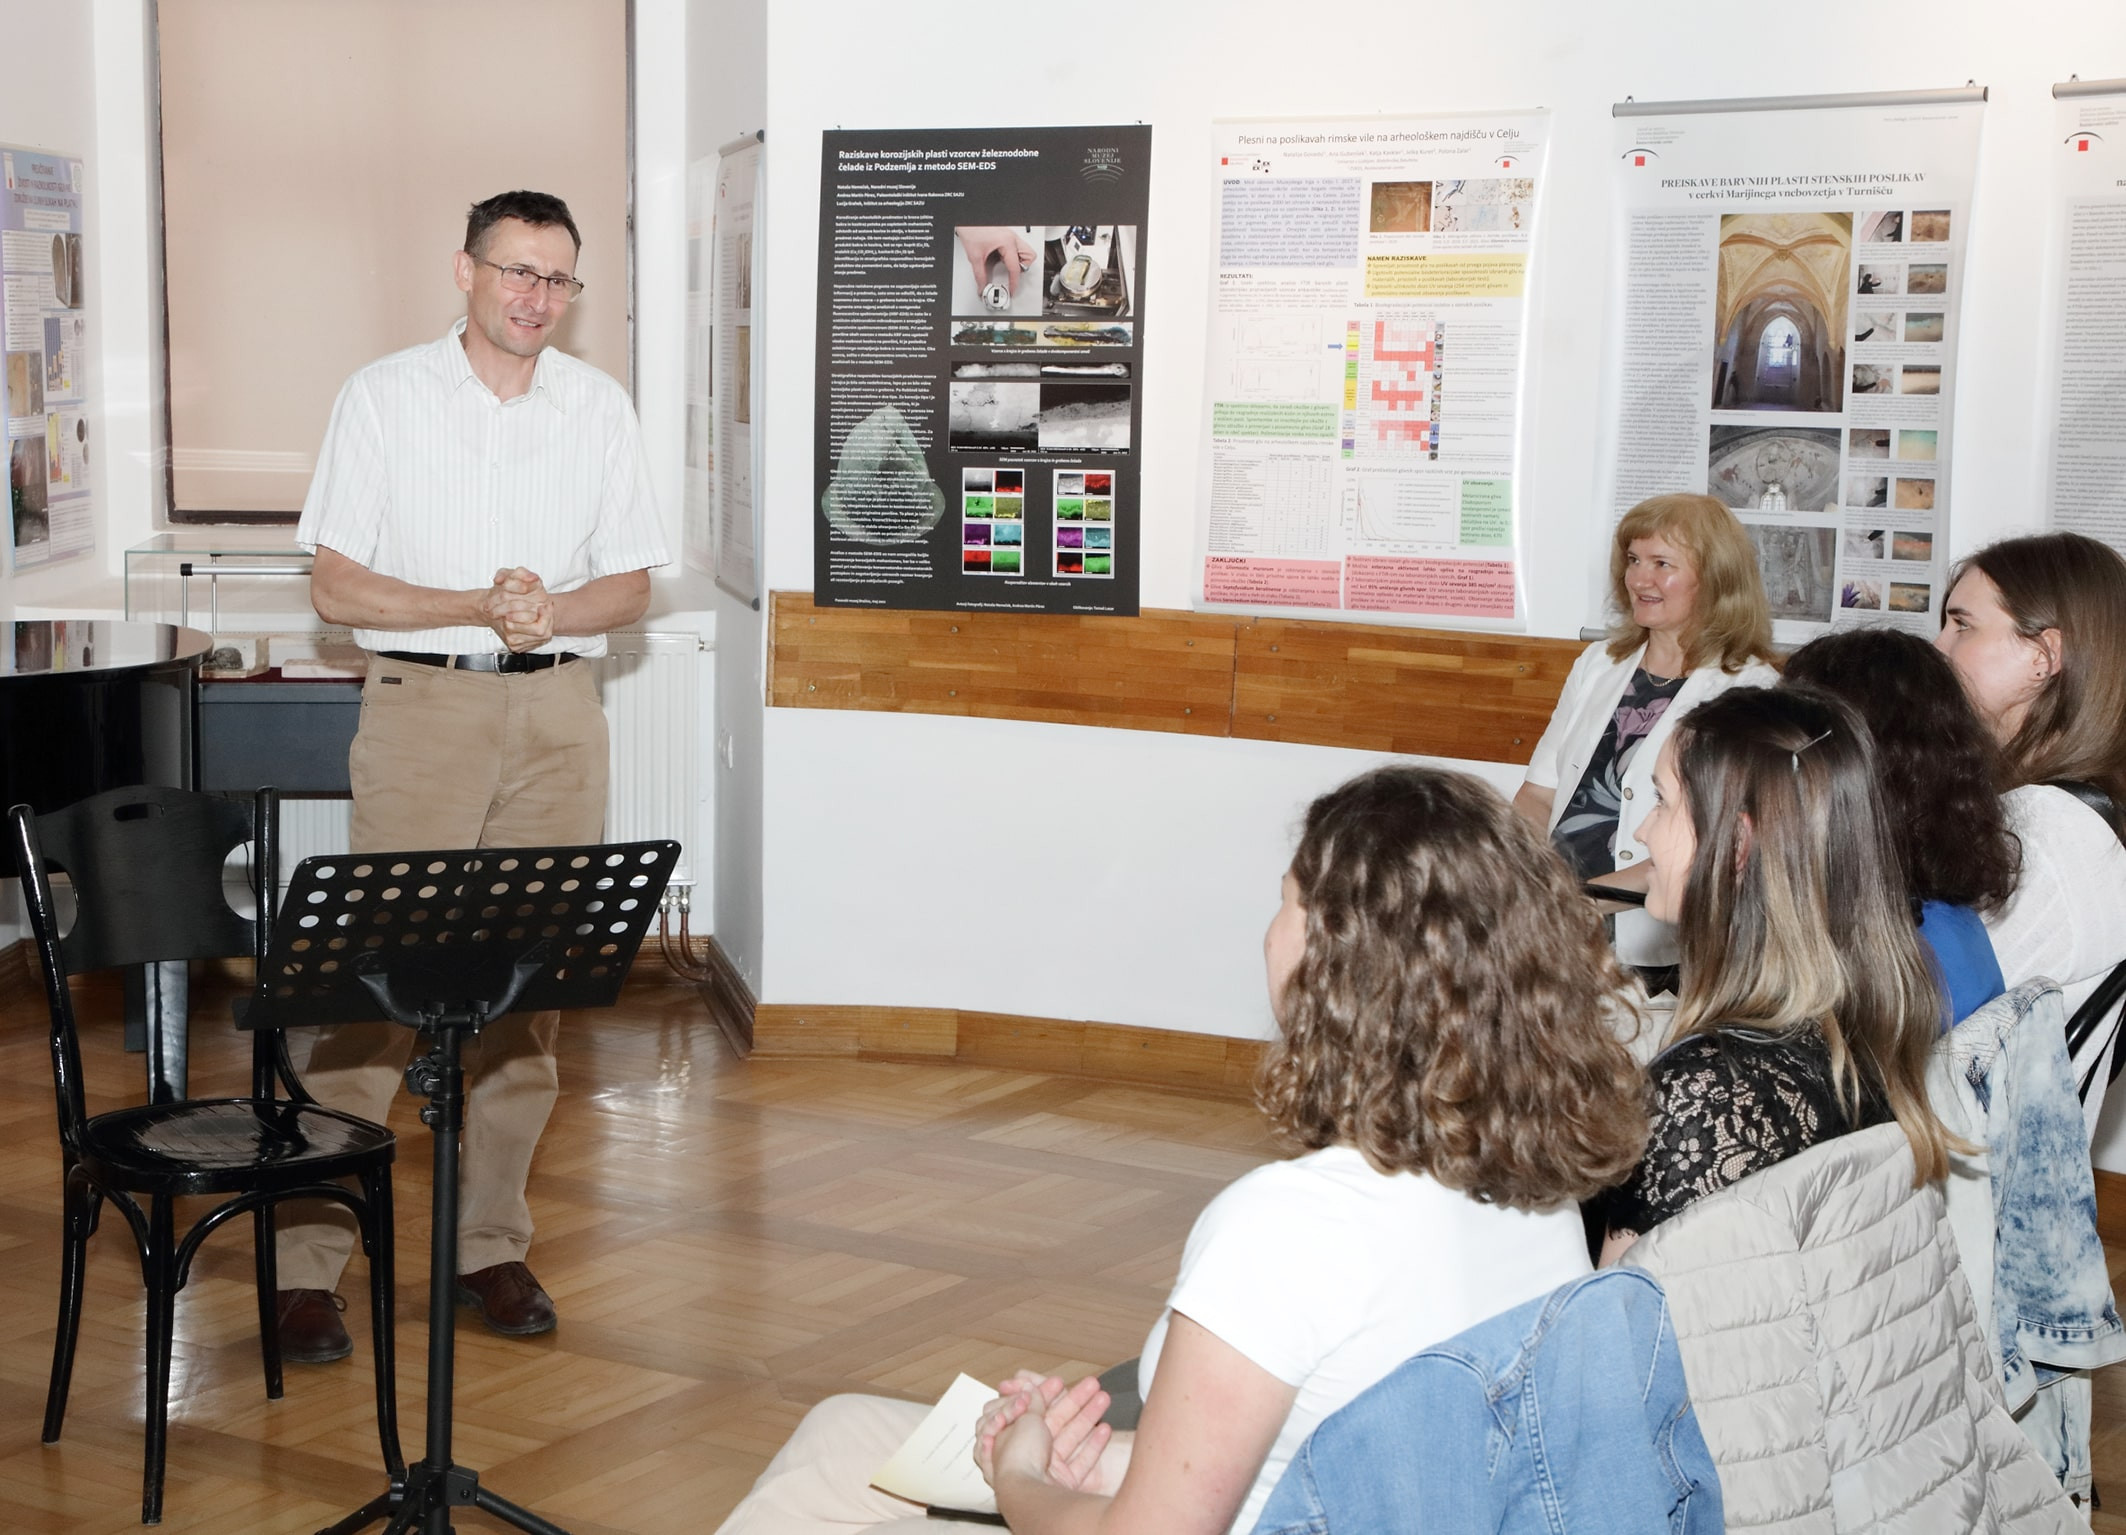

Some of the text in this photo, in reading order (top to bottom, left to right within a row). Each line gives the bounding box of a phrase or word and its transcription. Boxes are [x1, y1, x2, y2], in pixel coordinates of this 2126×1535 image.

[1238, 135, 1264, 144] Plesni
[1279, 134, 1325, 145] poslikavah
[1328, 134, 1357, 143] rimske
[1359, 133, 1374, 142] vile
[1390, 131, 1448, 142] arheološkem
[1451, 130, 1487, 141] najdišču
[1497, 129, 1520, 139] Celju
[839, 150, 879, 159] Raziskave
[880, 150, 924, 160] korozijskih
[925, 150, 948, 160] plasti
[982, 149, 1039, 157] železnodobne
[838, 163, 865, 171] čelade
[866, 162, 873, 171] iz
[874, 162, 917, 173] Podzemlja
[924, 162, 956, 170] metodo
[957, 162, 996, 170] SEM-EDS
[1661, 173, 1926, 188] PREISKAVE BARVNIH PLASTI STENSKIH POSLIKAV
[1695, 189, 1724, 199] cerkvi
[1726, 188, 1776, 200] Marijinega
[1779, 187, 1836, 199] vnebovzetja
[1847, 186, 1893, 196] Turnišču
